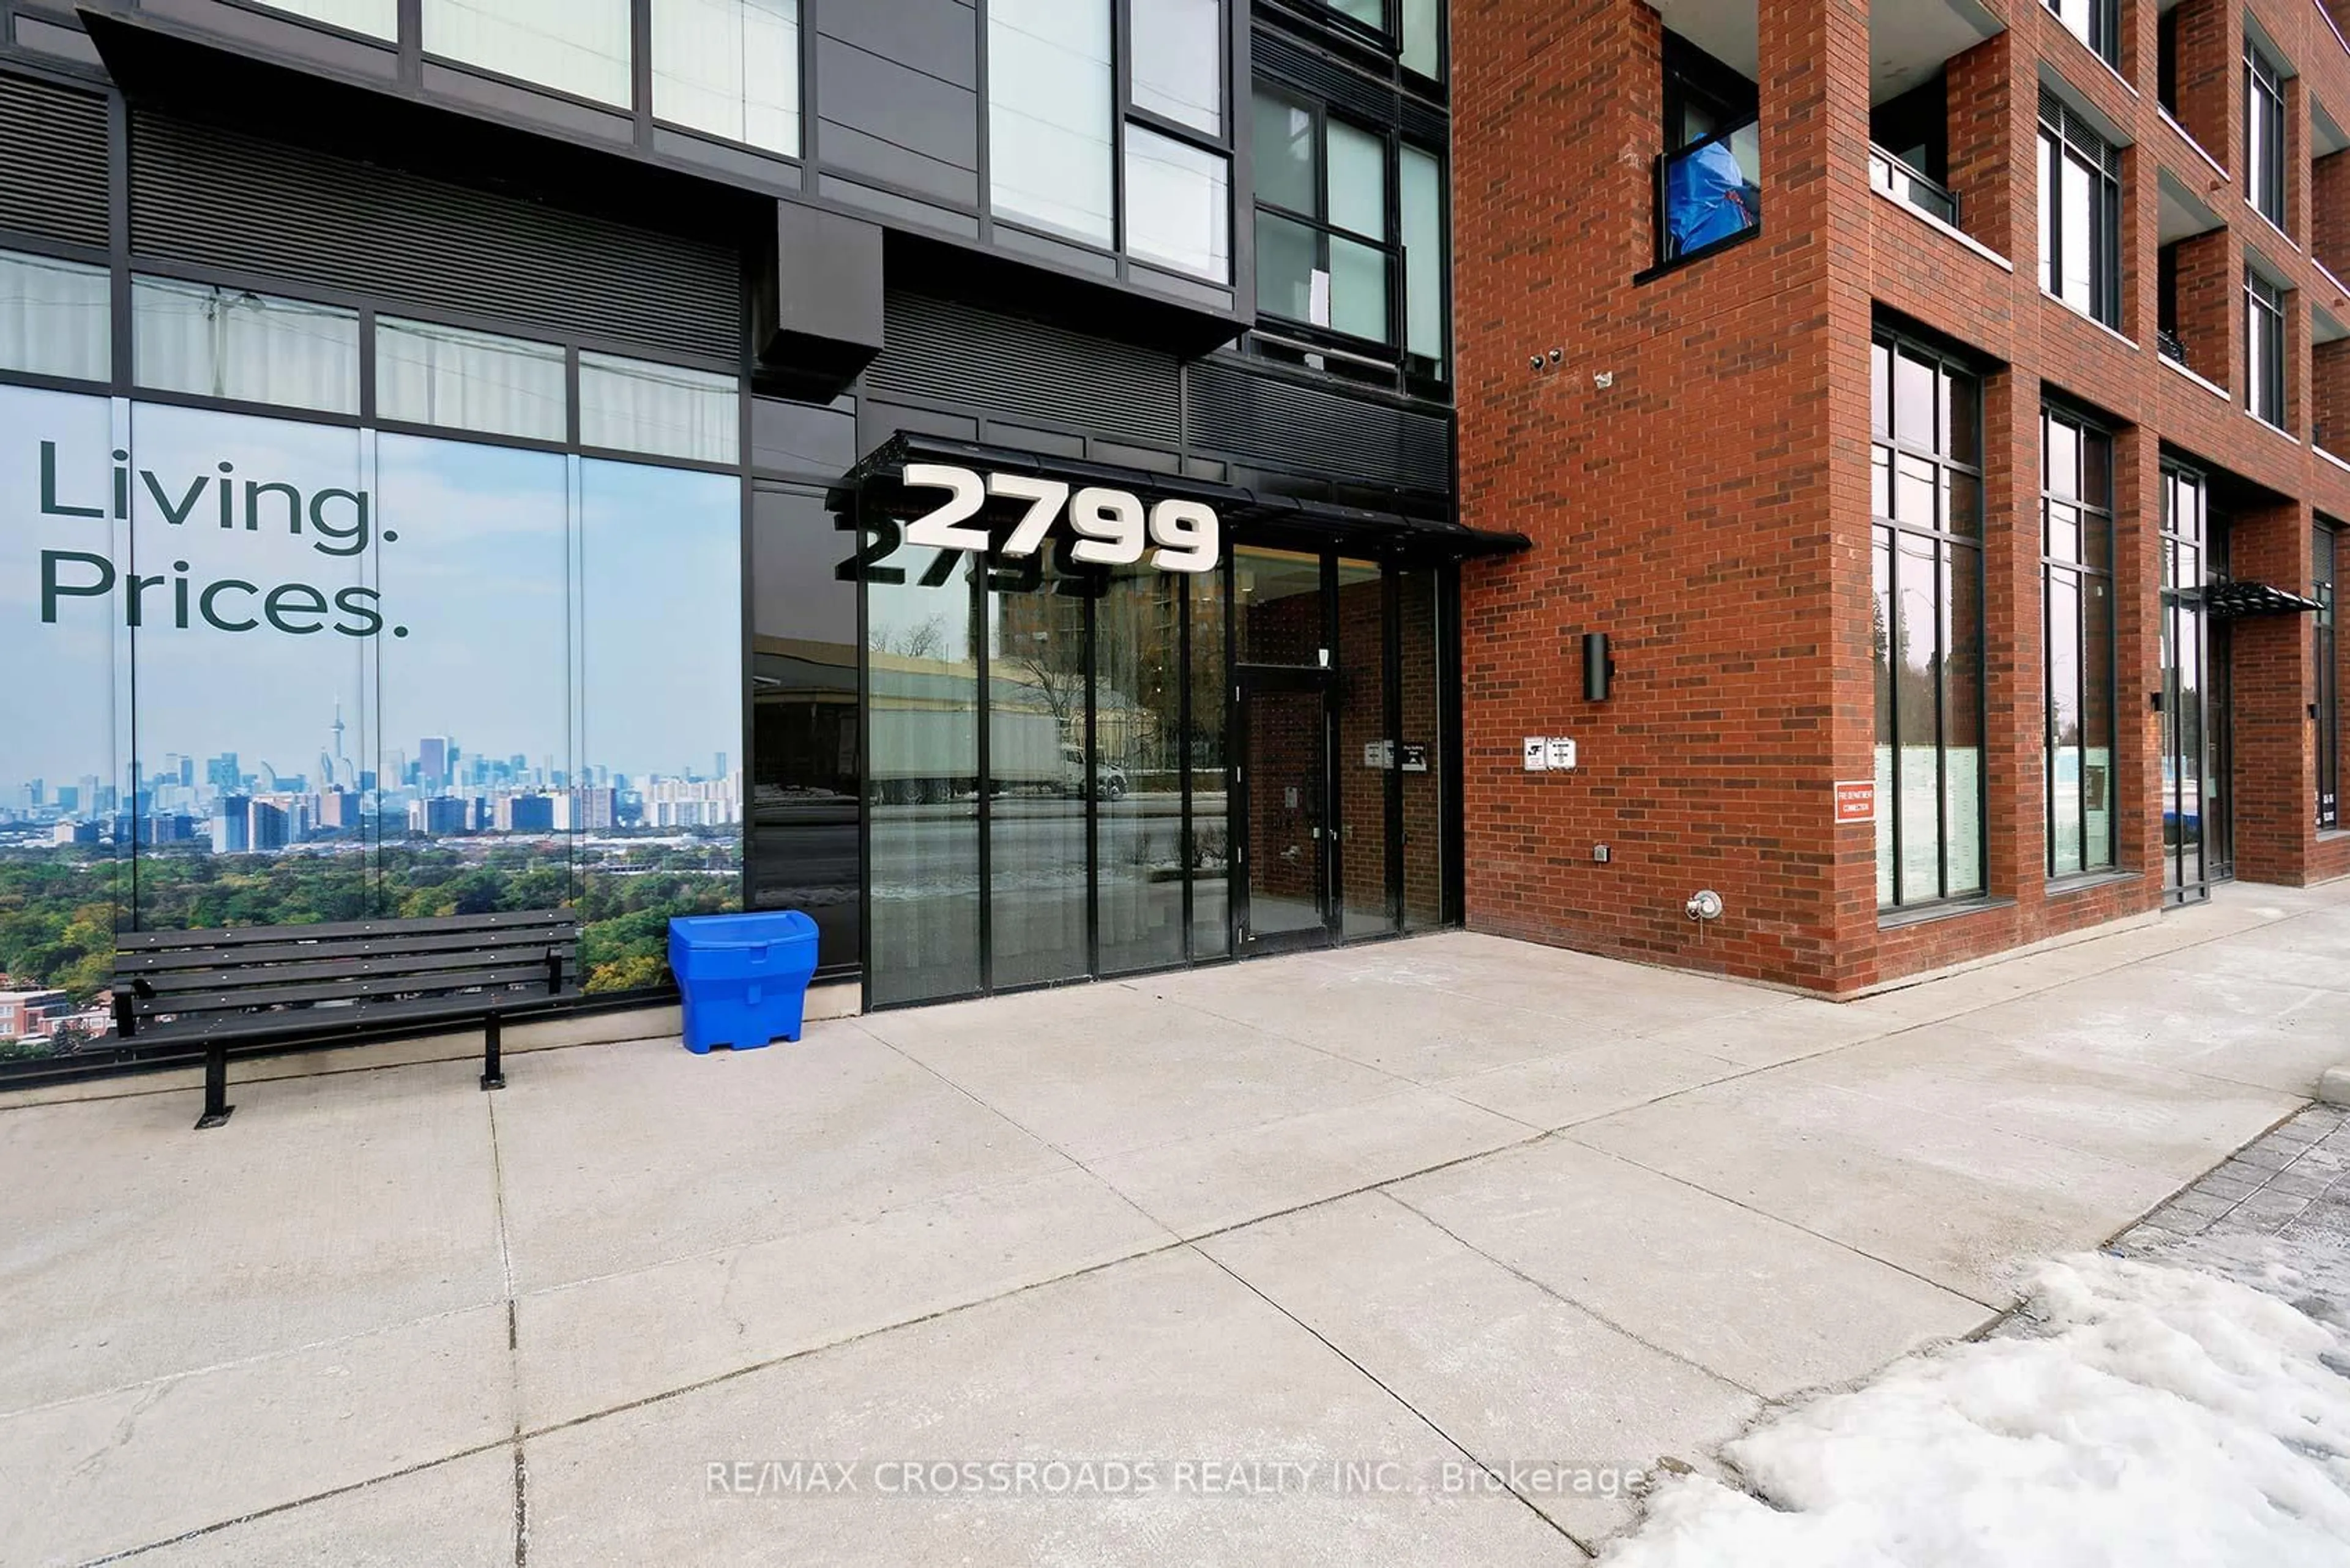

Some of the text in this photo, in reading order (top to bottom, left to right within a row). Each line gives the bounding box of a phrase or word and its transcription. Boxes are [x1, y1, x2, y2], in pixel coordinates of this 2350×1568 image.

[40, 440, 398, 556] Living.
[903, 463, 1220, 573] 2799
[40, 549, 409, 638] Prices.
